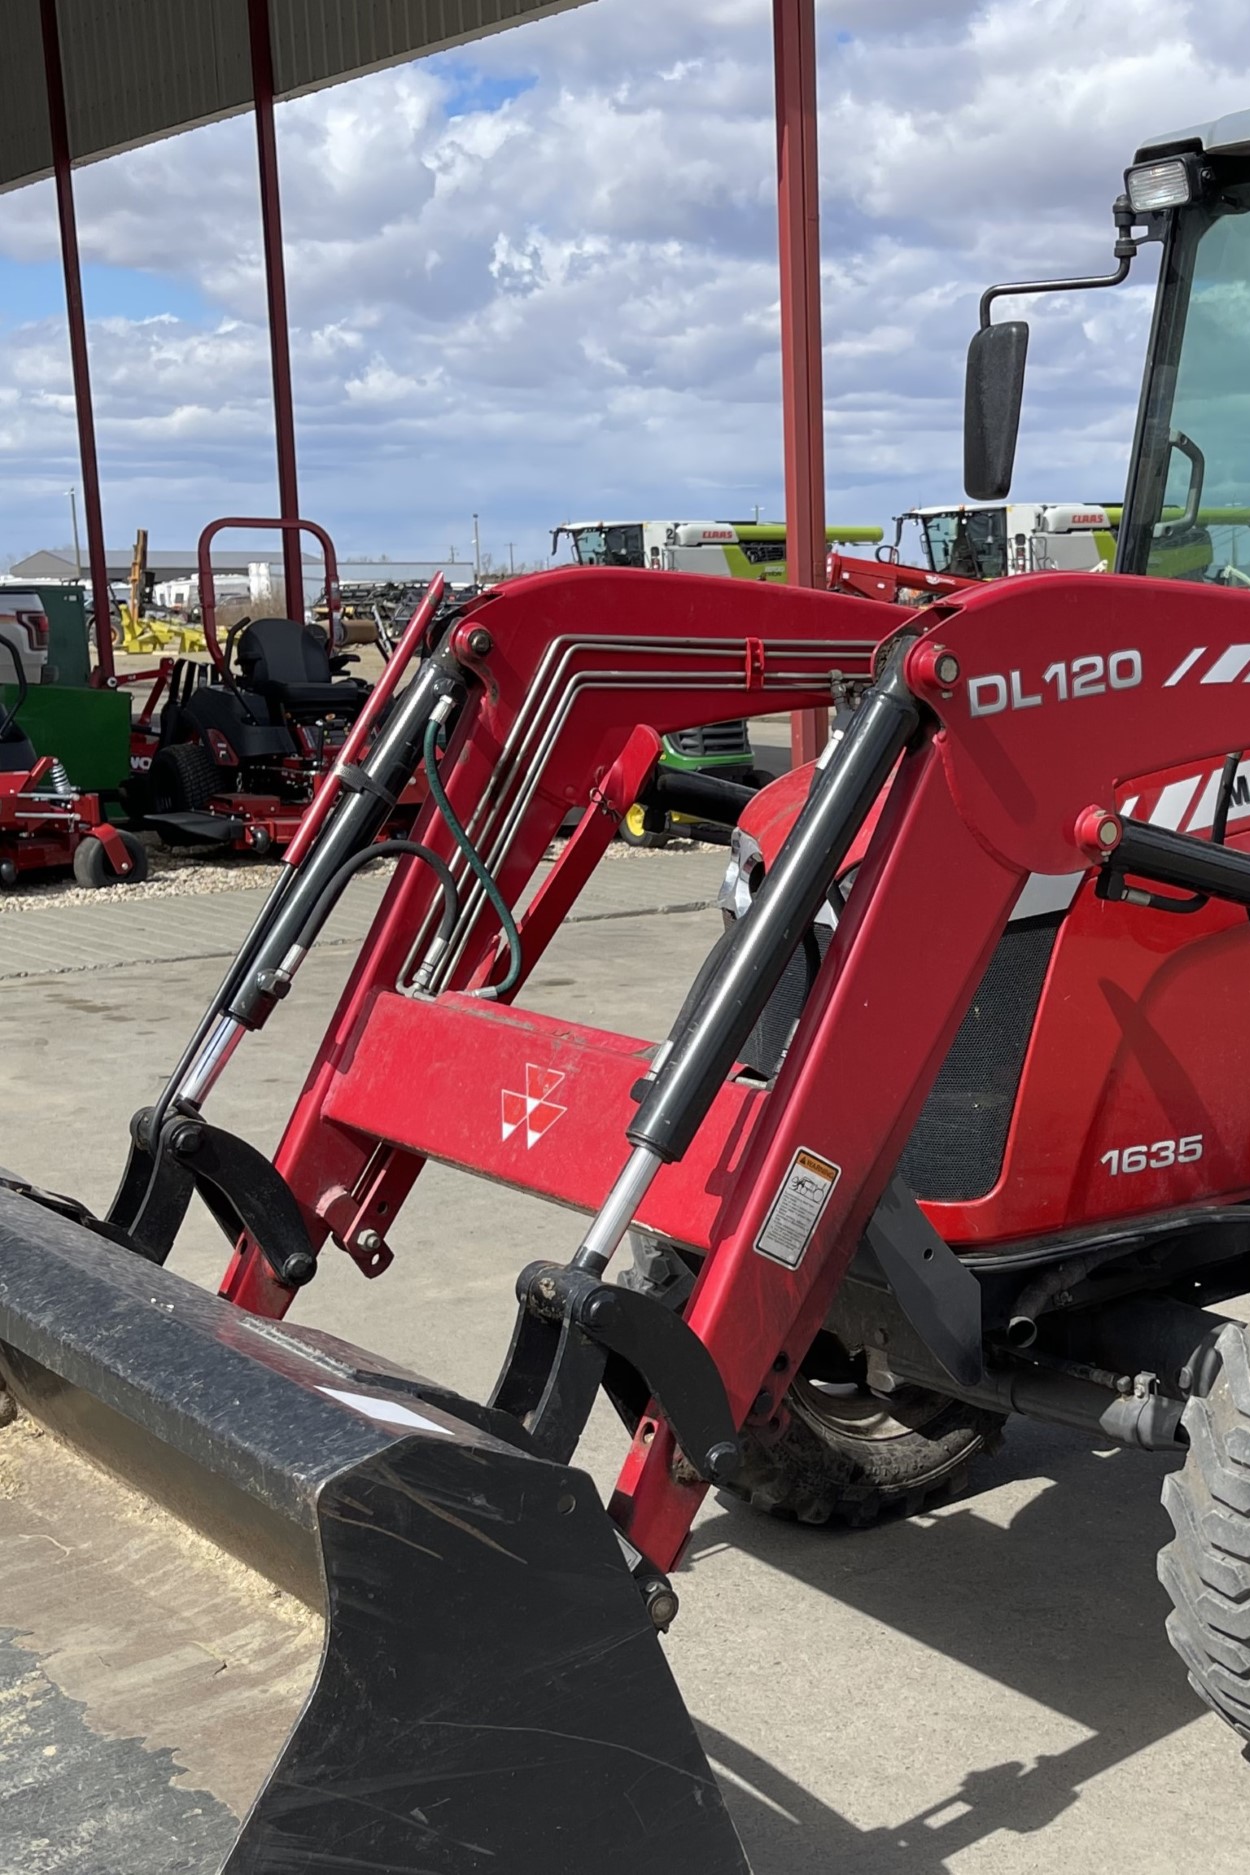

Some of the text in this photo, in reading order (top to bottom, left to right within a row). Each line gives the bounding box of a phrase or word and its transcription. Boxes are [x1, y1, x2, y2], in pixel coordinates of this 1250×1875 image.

[1071, 514, 1104, 524] CLAAS
[666, 528, 674, 539] 2
[702, 531, 733, 539] CLAAS
[1100, 1134, 1203, 1176] 1635
[806, 1161, 834, 1178] WARNING
